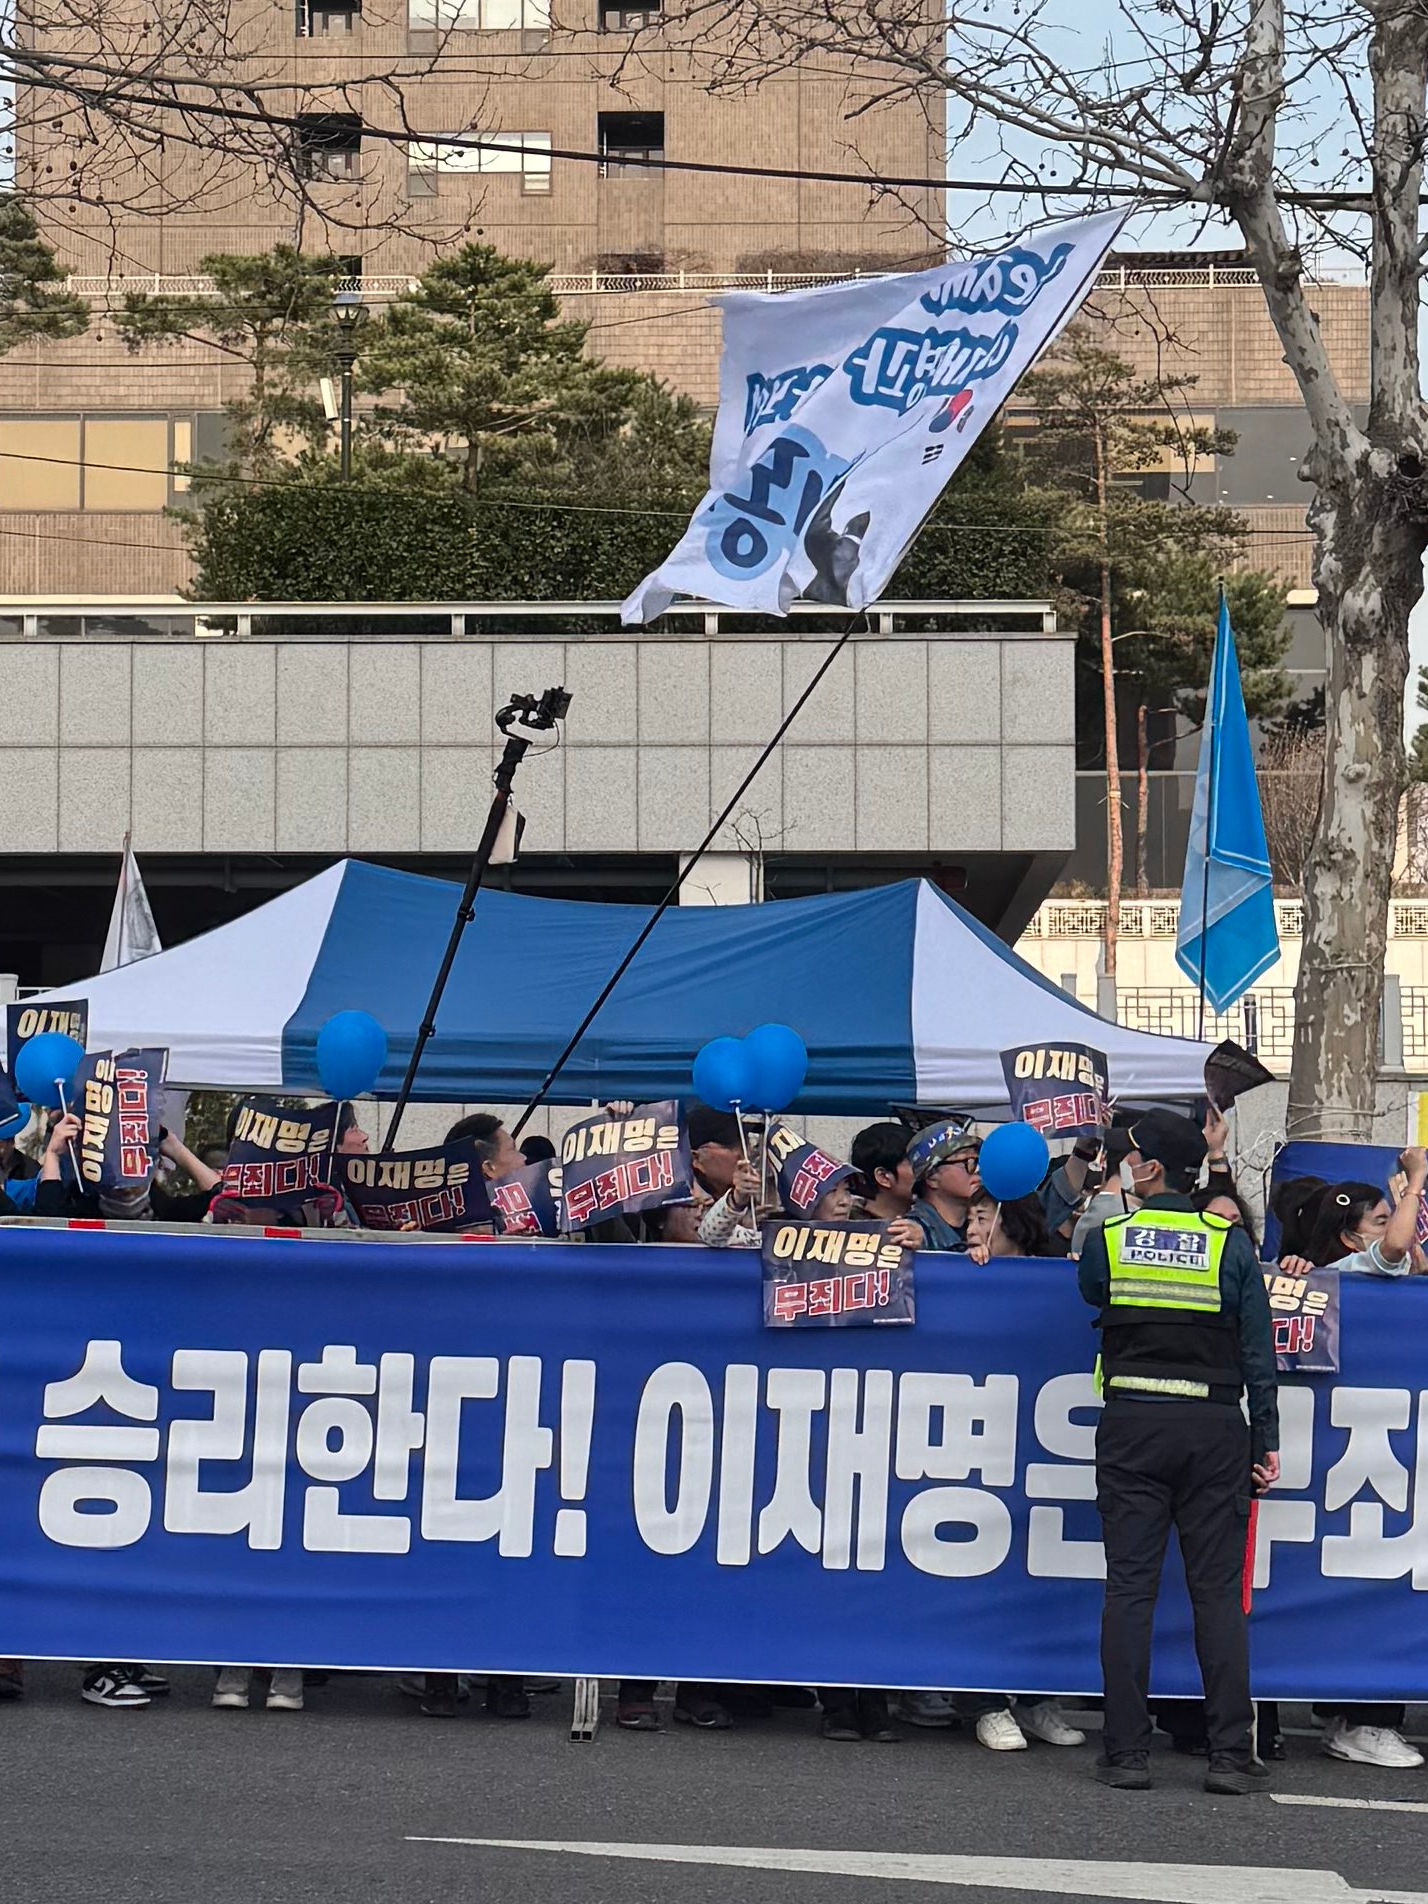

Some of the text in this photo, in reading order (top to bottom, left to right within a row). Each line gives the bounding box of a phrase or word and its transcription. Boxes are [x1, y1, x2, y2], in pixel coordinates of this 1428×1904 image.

[81, 1059, 116, 1183] 이재명은
[234, 1106, 331, 1153] 이재명은
[562, 1116, 680, 1165] 이재명은
[347, 1157, 470, 1190] 이재명은
[565, 1150, 675, 1223] 무죄다!
[772, 1226, 903, 1270] 이재명은
[1130, 1250, 1205, 1268] POLICE
[774, 1269, 891, 1322] 무죄다!
[35, 1339, 597, 1558] 승리한다!
